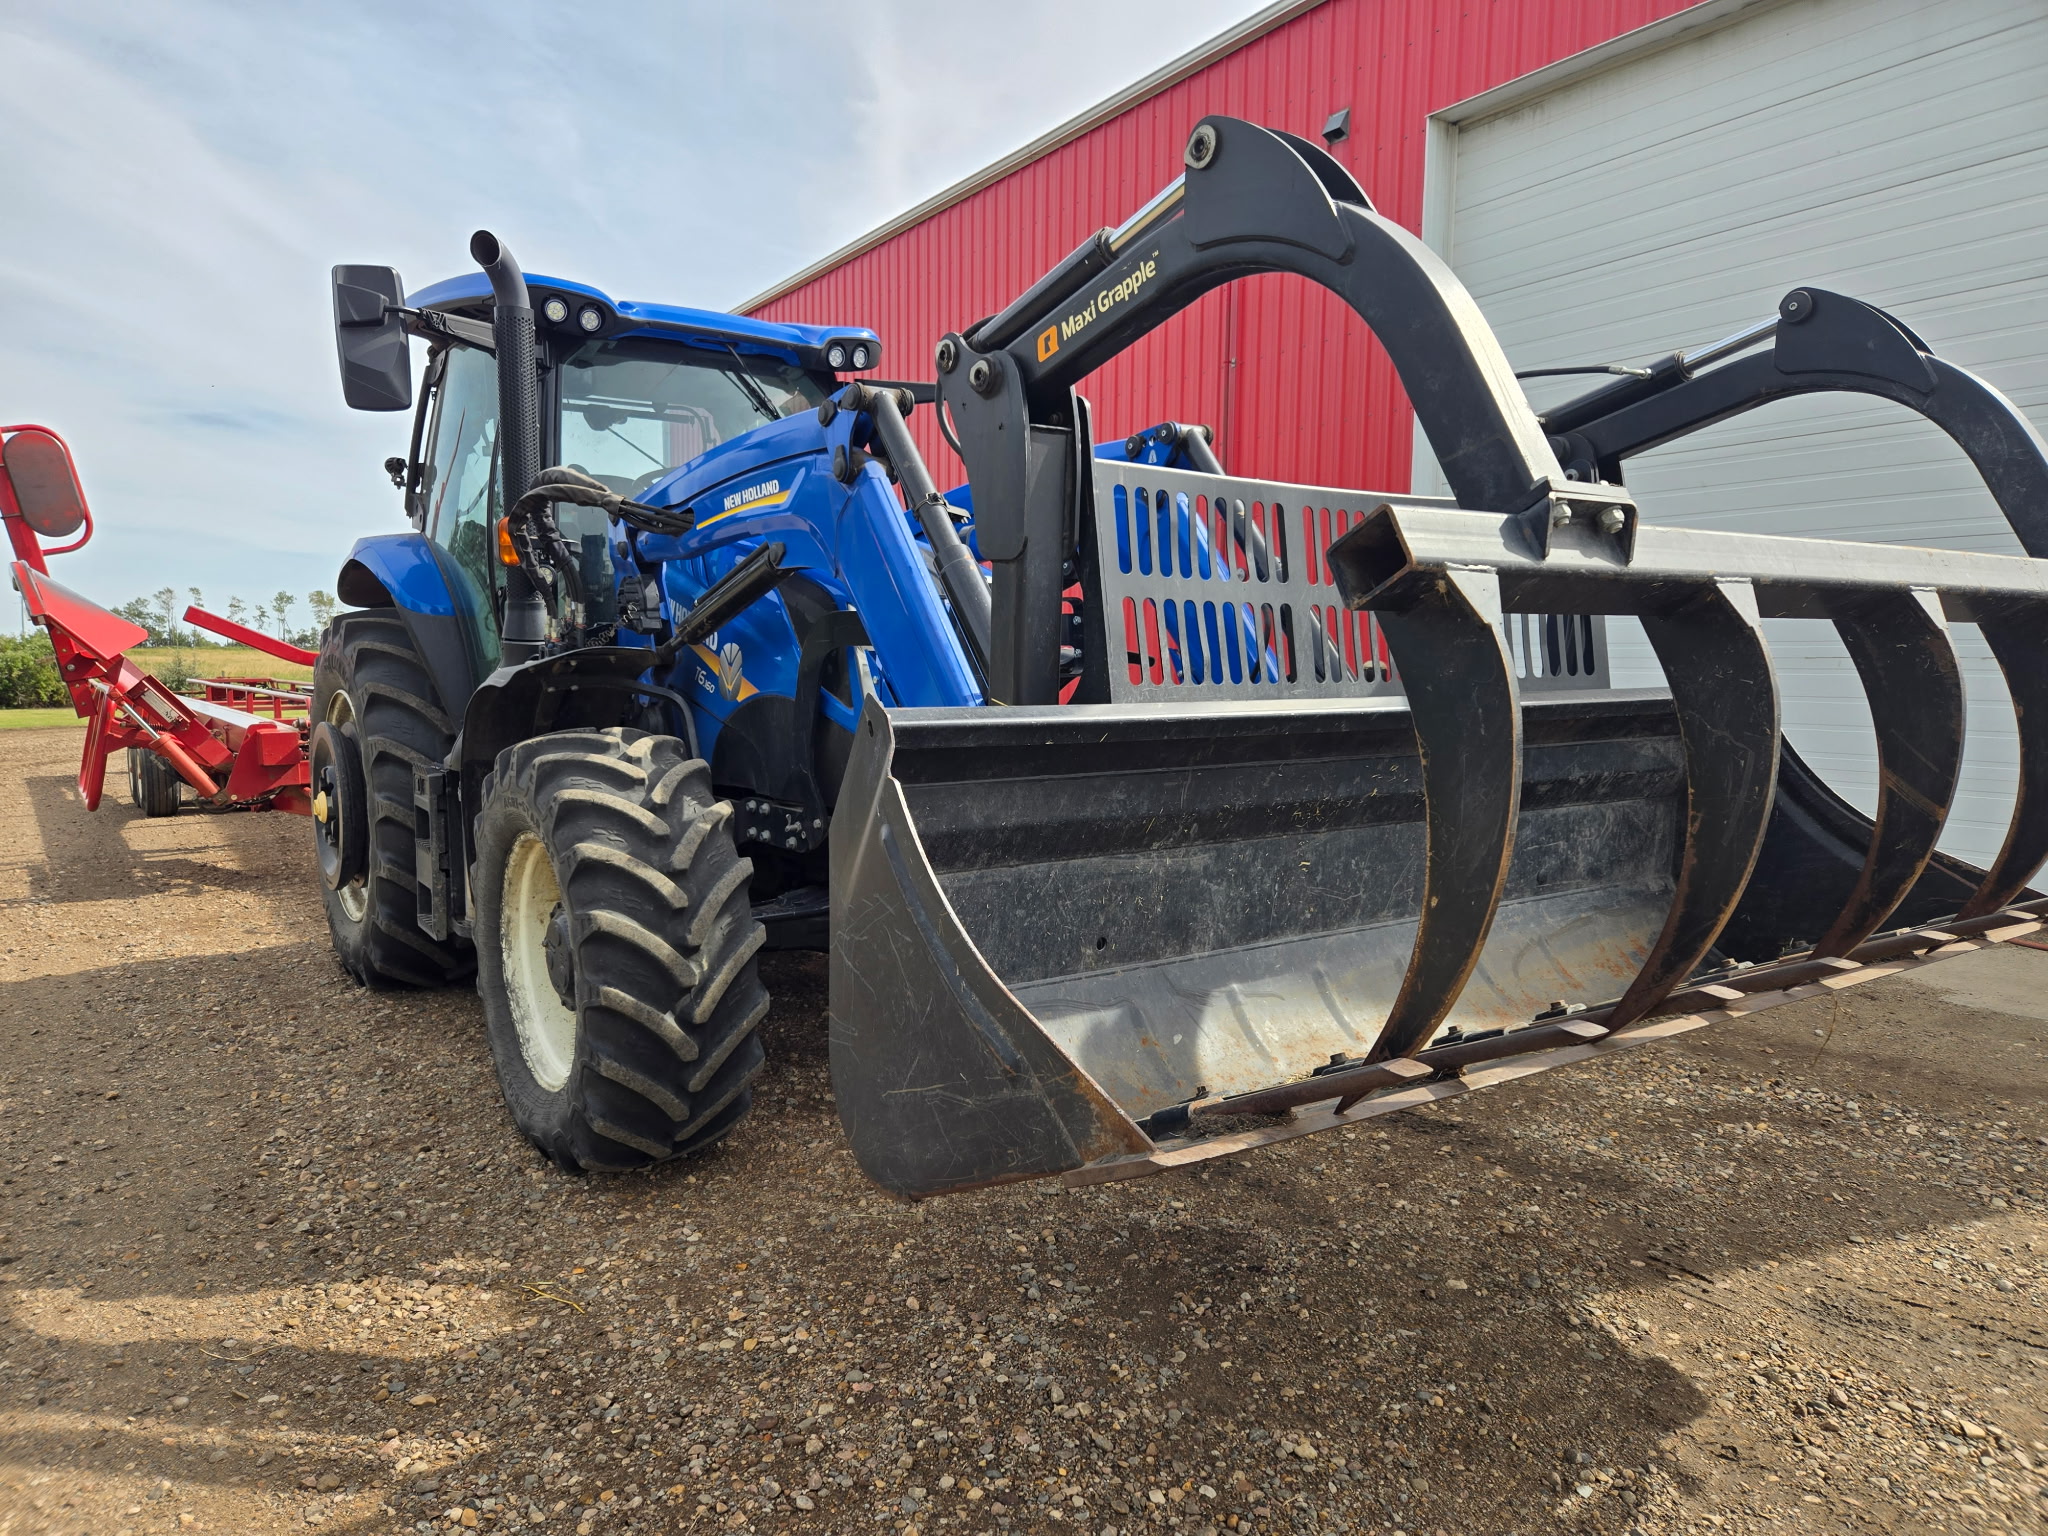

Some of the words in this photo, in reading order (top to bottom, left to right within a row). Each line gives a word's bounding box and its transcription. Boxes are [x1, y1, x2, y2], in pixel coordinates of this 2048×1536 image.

[1061, 299, 1097, 341] Maxi
[723, 491, 742, 511] NEW
[741, 479, 780, 504] HOLLAND
[694, 665, 716, 694] T6.160
